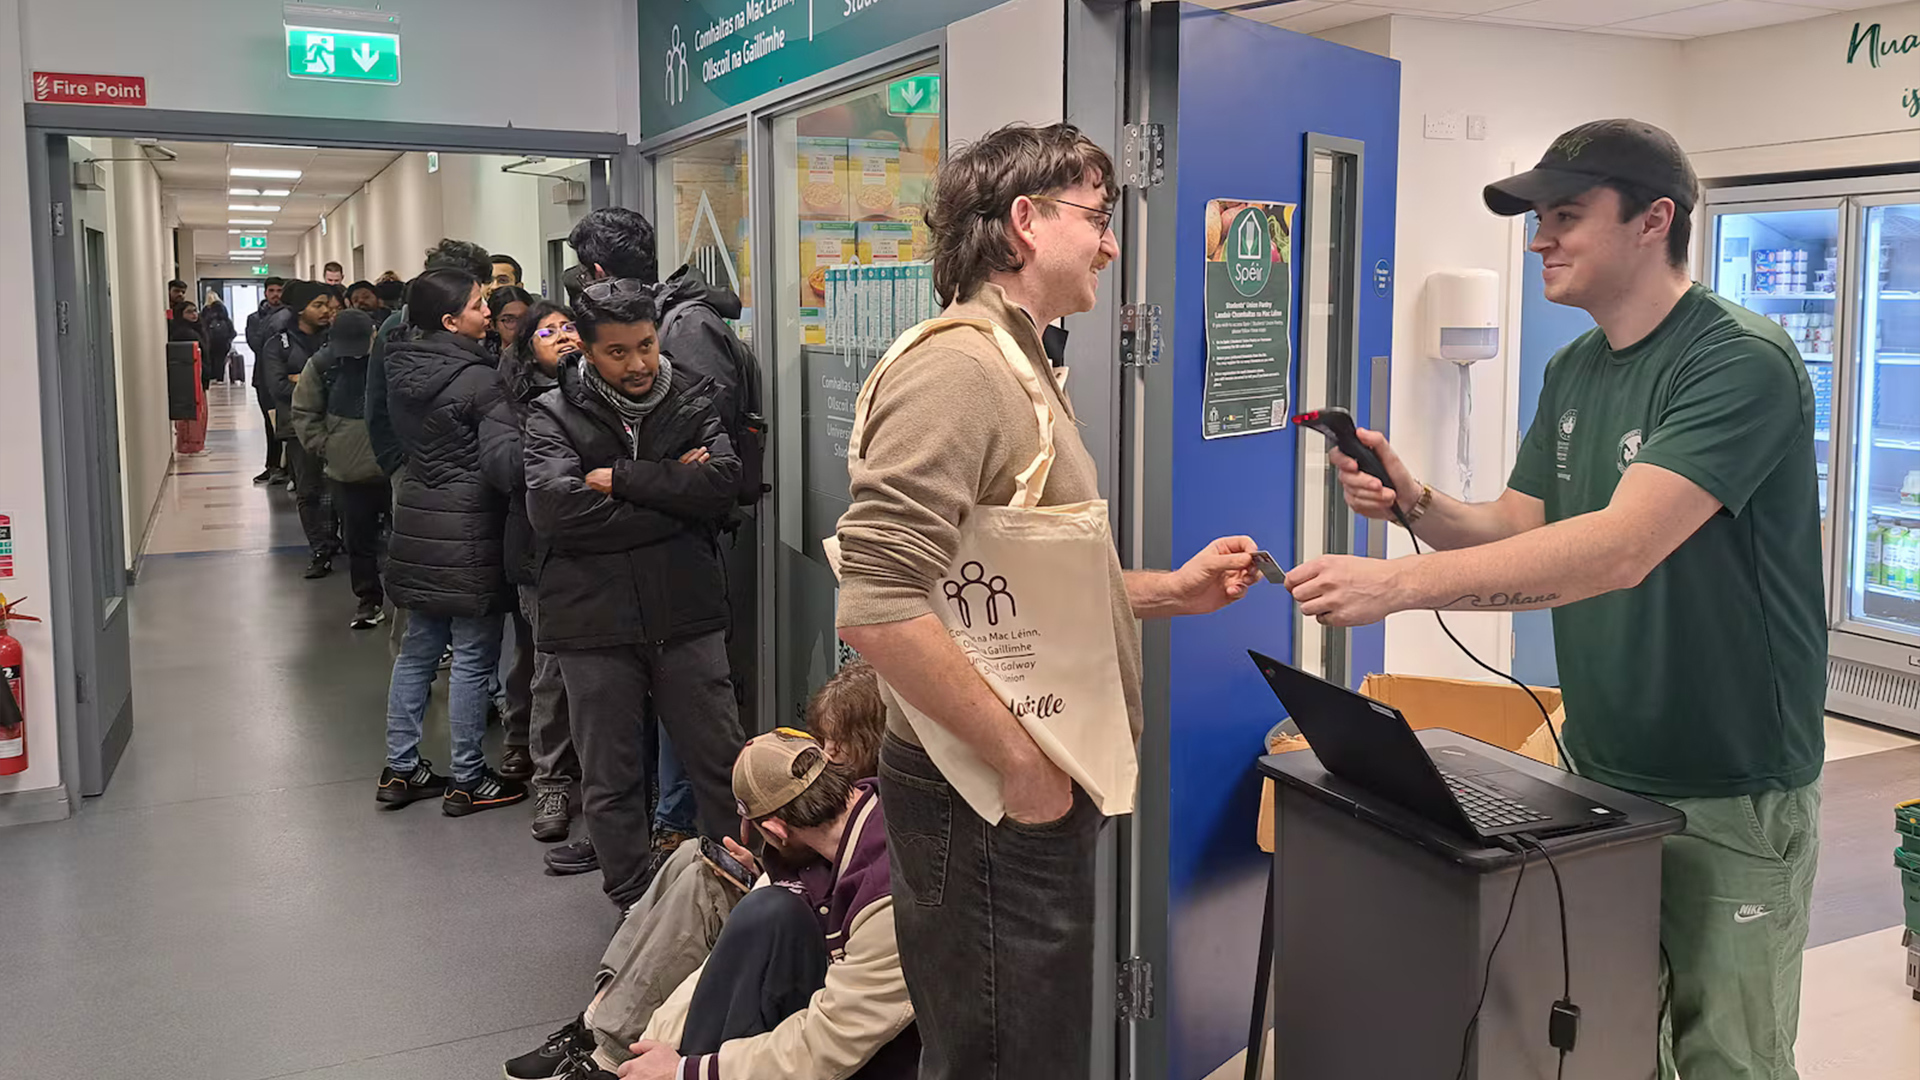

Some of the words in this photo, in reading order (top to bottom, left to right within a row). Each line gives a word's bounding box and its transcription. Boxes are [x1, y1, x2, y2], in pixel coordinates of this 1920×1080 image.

[694, 16, 733, 52] Comhaltas
[734, 10, 745, 31] na
[746, 0, 764, 25] Mac
[702, 49, 731, 83] Ollscoil
[732, 50, 741, 70] na
[743, 26, 785, 64] Gaillimhe
[53, 80, 88, 96] Fire
[95, 82, 141, 99] Point
[1235, 262, 1263, 285] Spéir
[821, 375, 851, 392] Comhaltas
[851, 383, 859, 393] na
[827, 396, 849, 412] Ollscoil
[1490, 592, 1561, 606] Ohana
[989, 632, 1009, 642] Mac
[1011, 628, 1041, 640] Léinn,
[988, 643, 1032, 656] Gaillimhe
[1000, 660, 1036, 672] Galway
[1739, 904, 1766, 915] NIKE
